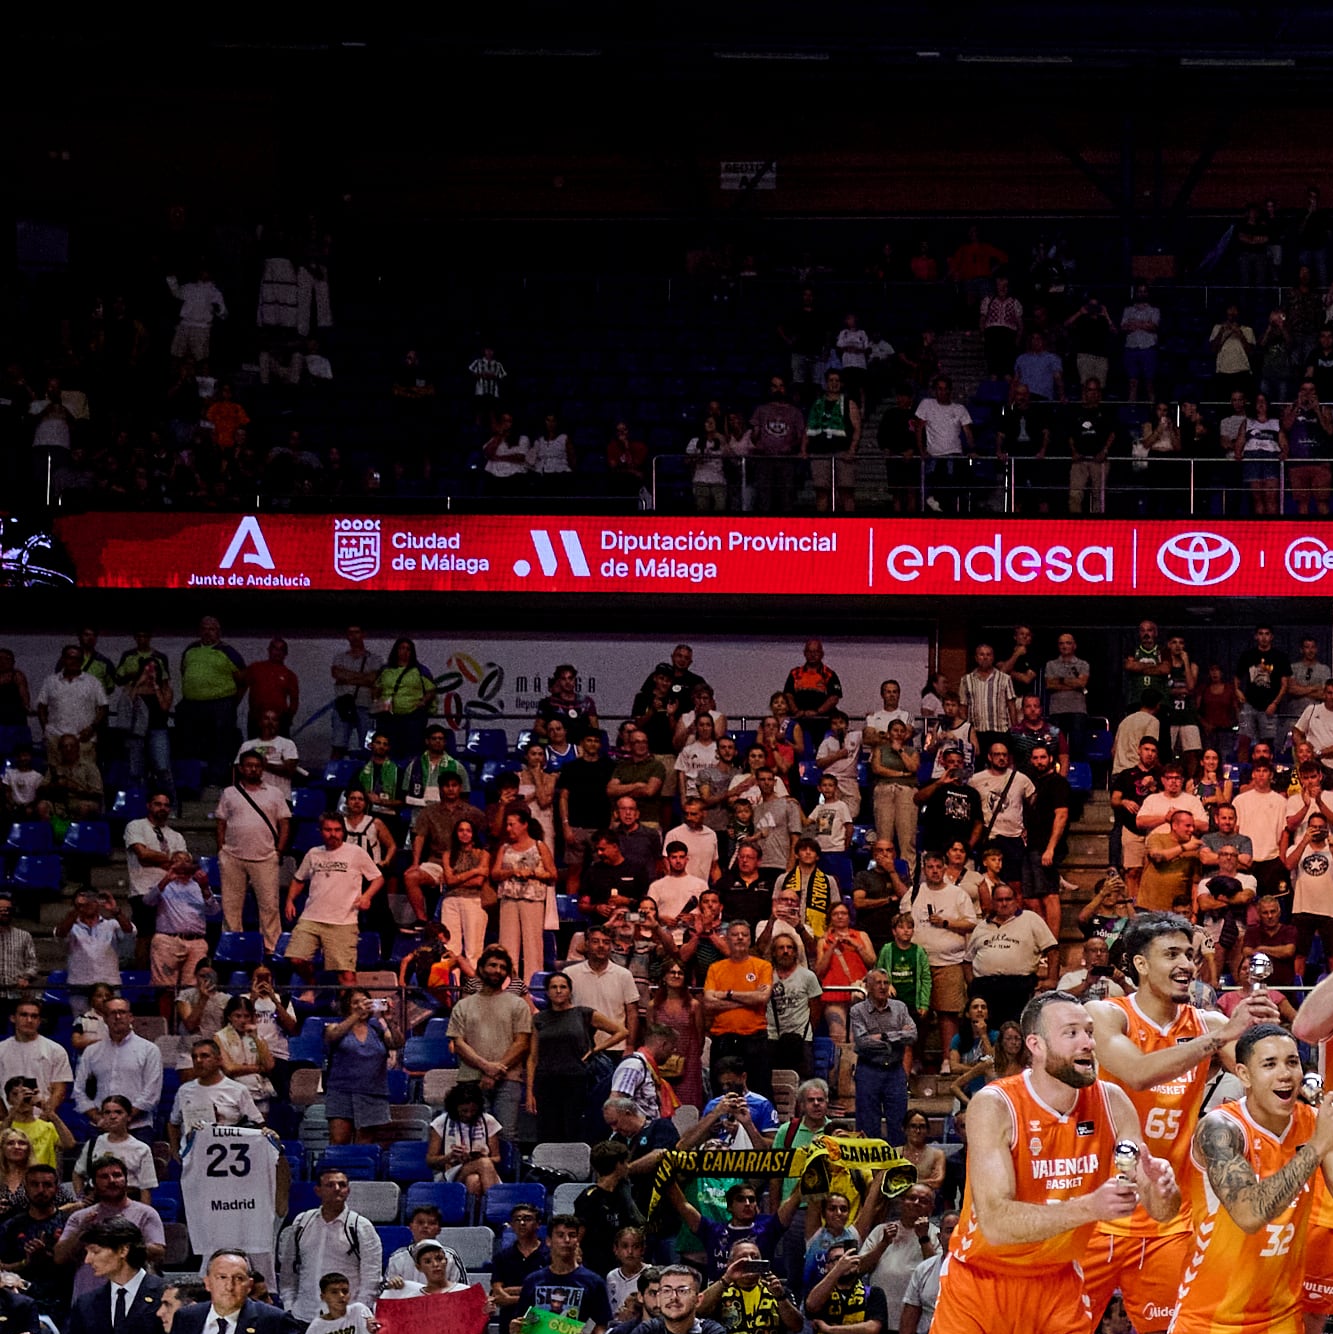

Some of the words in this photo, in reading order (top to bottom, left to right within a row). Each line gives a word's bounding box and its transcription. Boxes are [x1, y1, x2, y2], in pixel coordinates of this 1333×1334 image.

[392, 532, 460, 549] Ciudad
[602, 531, 721, 554] Diputación
[729, 532, 836, 551] Provincial
[392, 555, 415, 570] de
[422, 553, 489, 574] Málaga
[887, 534, 1113, 582] endesa
[188, 574, 224, 585] Junta
[228, 574, 243, 585] de
[247, 574, 310, 586] Andalucía
[601, 559, 628, 577] de
[636, 558, 716, 582] Málaga
[1145, 1108, 1181, 1139] 65
[206, 1143, 251, 1178] 23
[1032, 1153, 1098, 1181] VALENCIA
[1046, 1176, 1082, 1189] BASKET
[211, 1199, 255, 1211] Madrid
[1264, 1223, 1294, 1256] 32
